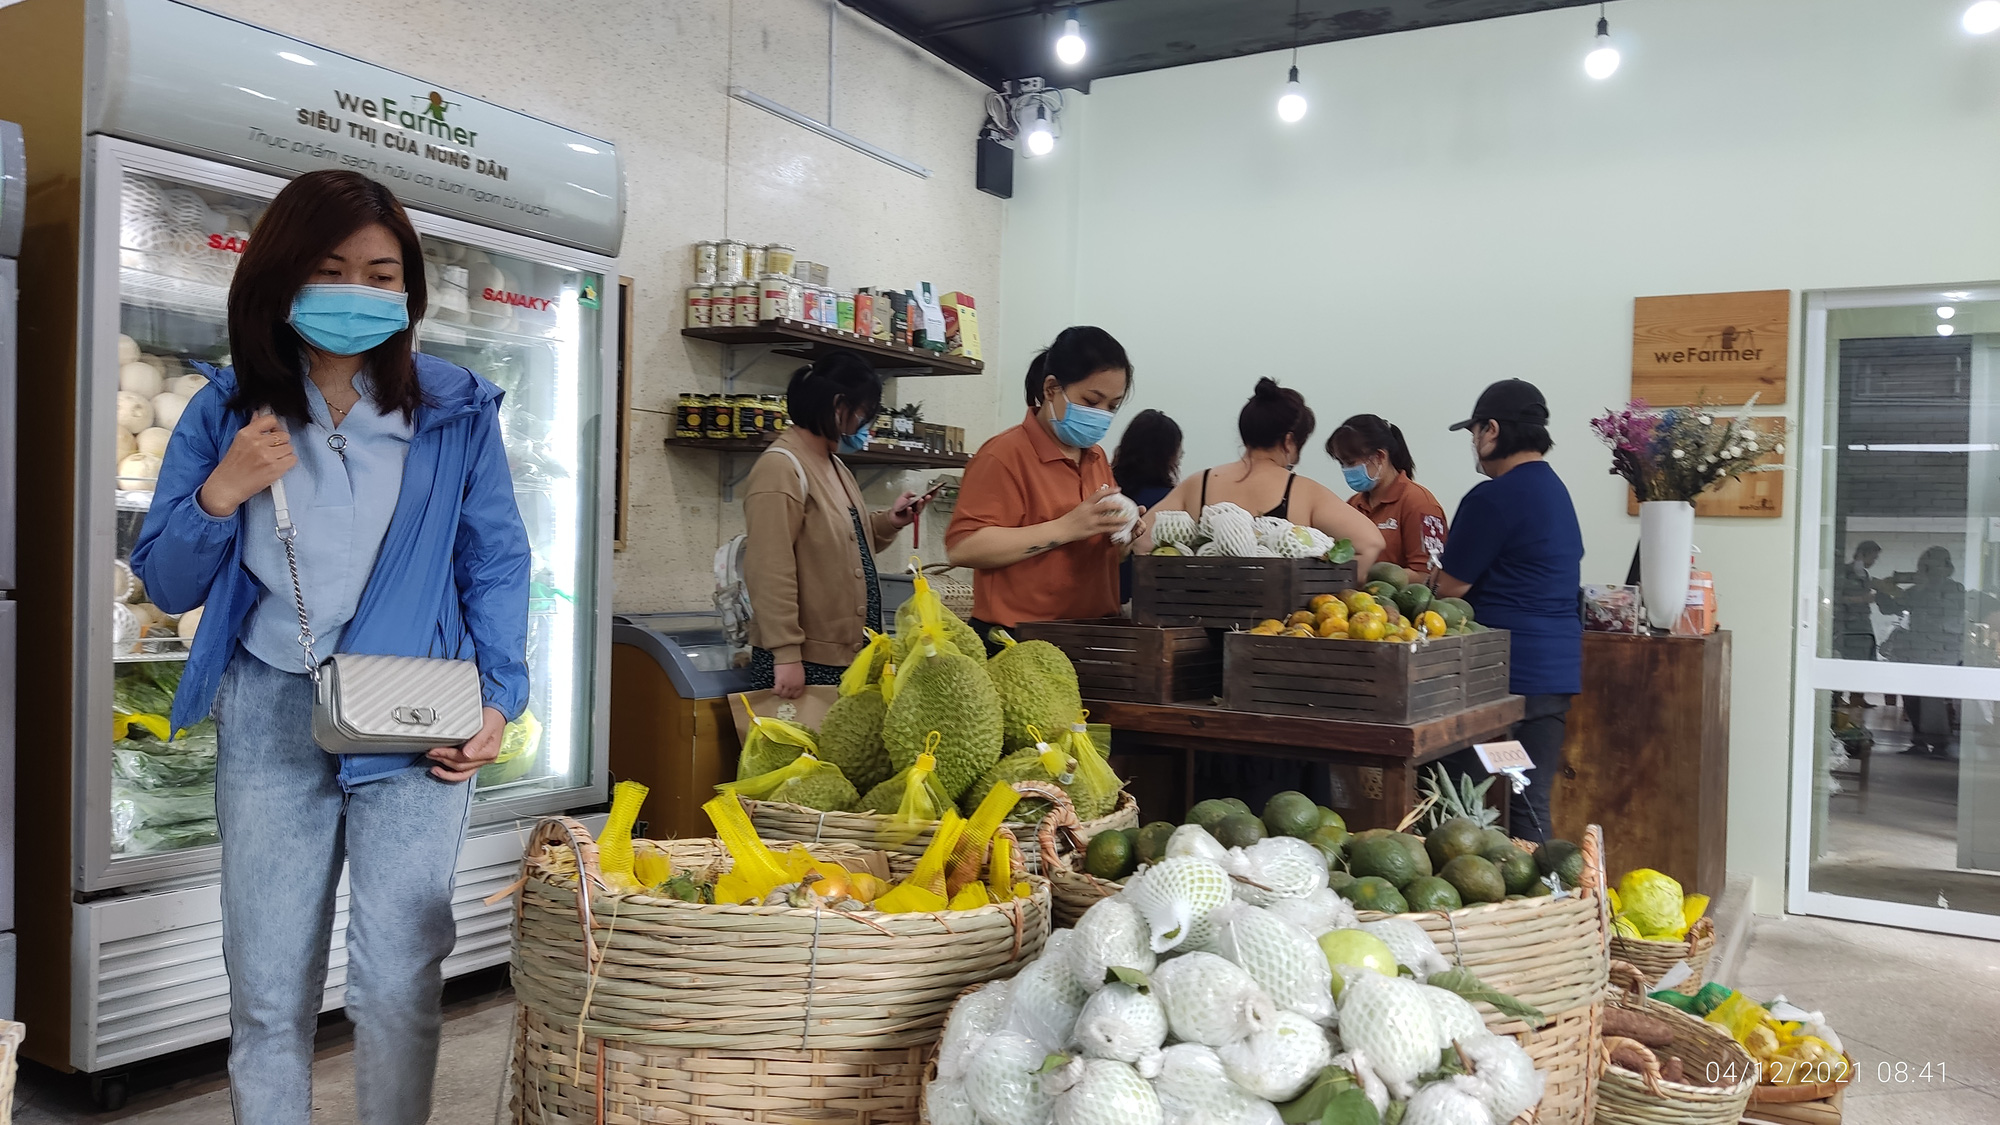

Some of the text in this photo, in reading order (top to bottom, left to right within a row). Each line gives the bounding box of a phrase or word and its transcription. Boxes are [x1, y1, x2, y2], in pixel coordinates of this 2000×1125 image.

[248, 126, 289, 149] Thực
[290, 140, 338, 161] phẩm
[466, 187, 502, 205] ngon
[296, 108, 341, 133] SIÊU
[347, 121, 377, 148] THỊ
[383, 131, 419, 156] CỦA
[475, 158, 509, 182] DÂN
[482, 287, 551, 312] SANAKY
[1654, 347, 1764, 363] weFarmer
